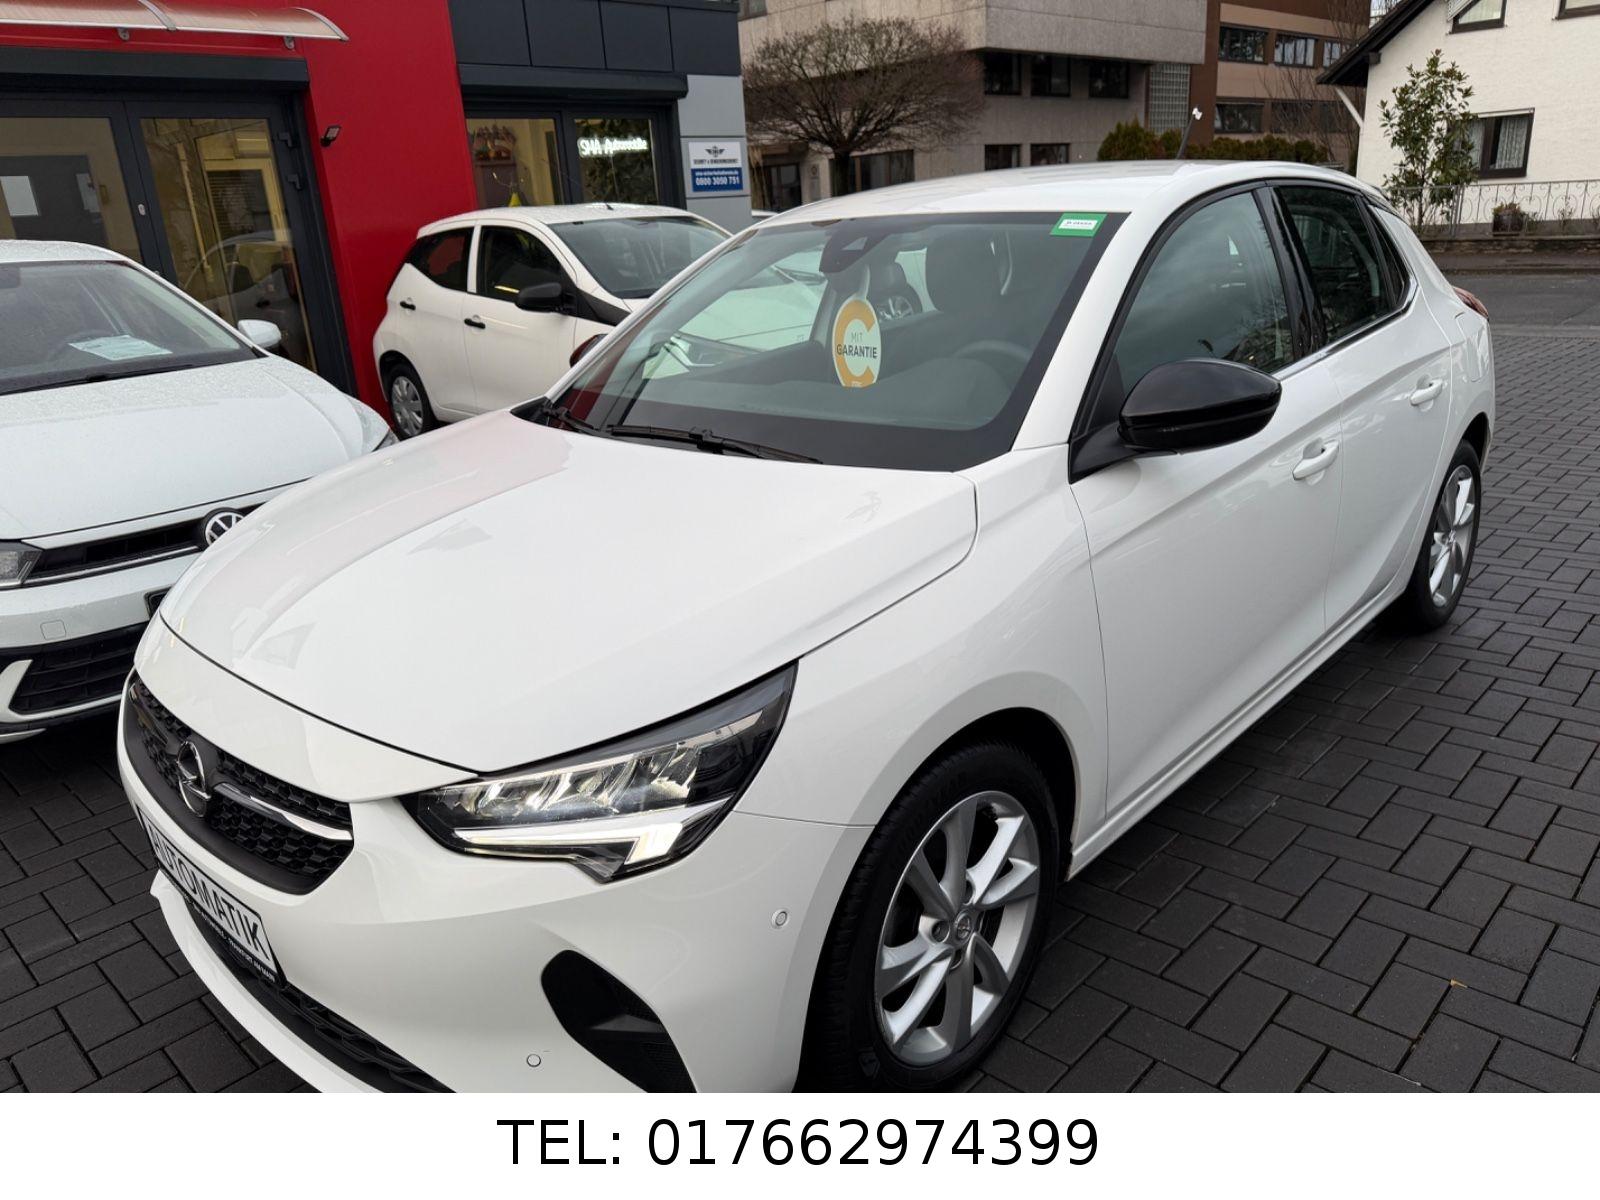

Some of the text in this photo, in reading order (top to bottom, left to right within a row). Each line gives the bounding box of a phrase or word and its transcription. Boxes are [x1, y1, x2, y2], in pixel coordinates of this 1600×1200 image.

[851, 332, 863, 342] MIT
[836, 343, 878, 359] GARANTIE
[147, 823, 271, 962] AUTOMATIK
